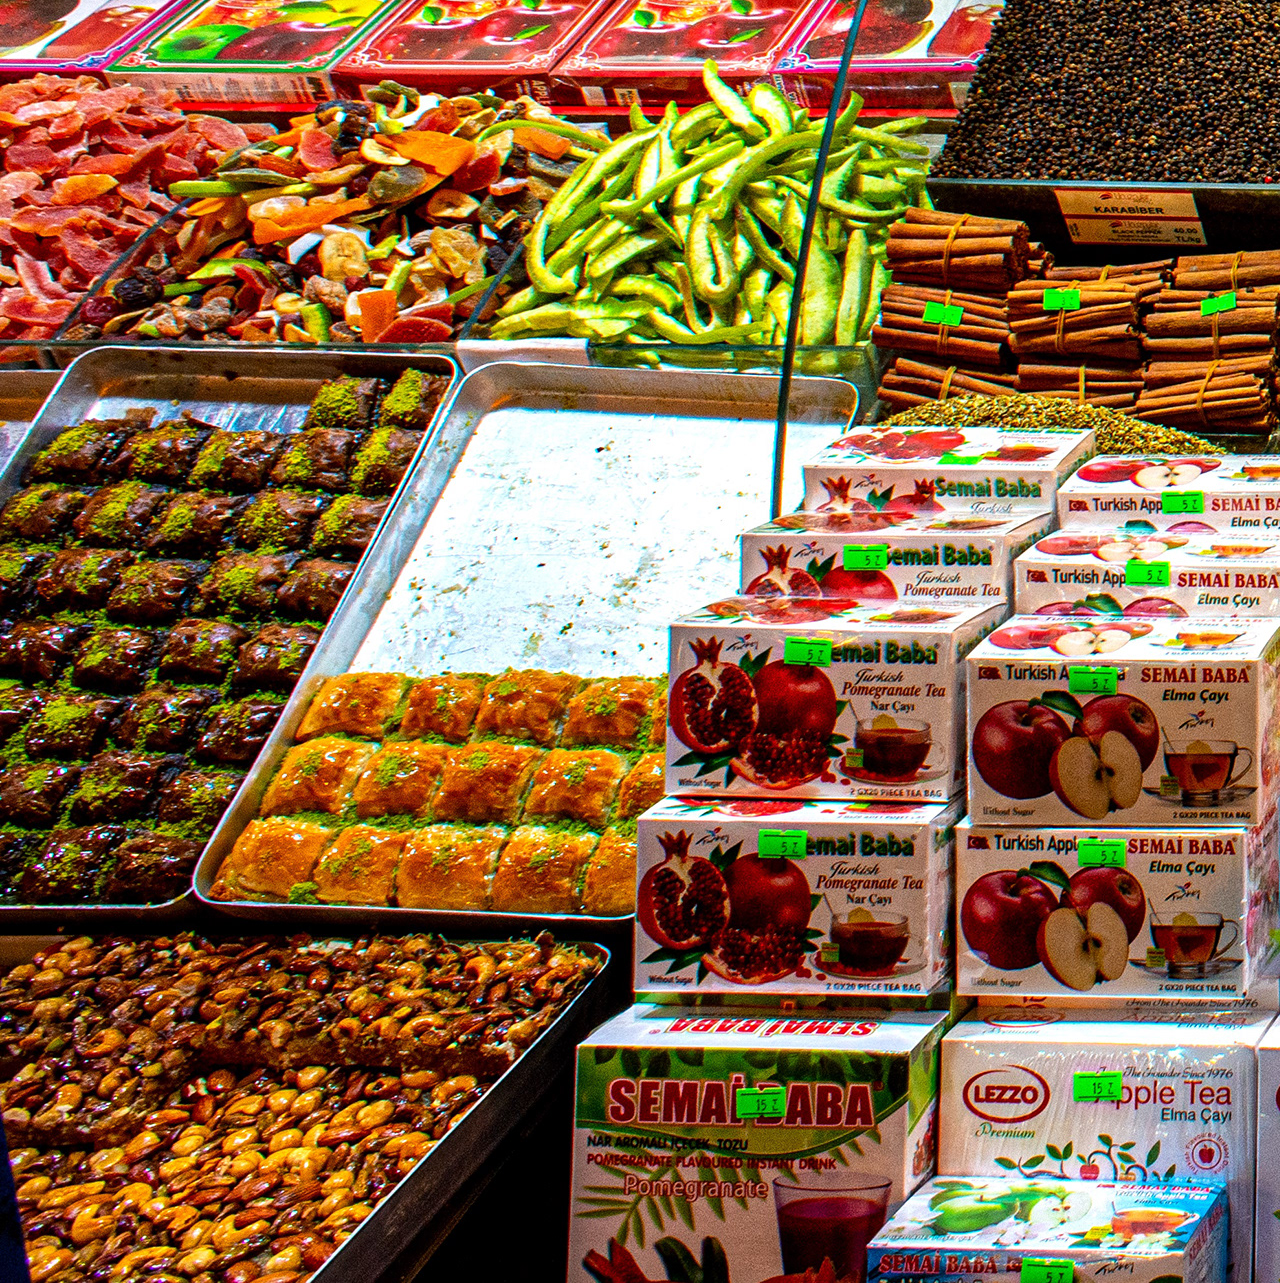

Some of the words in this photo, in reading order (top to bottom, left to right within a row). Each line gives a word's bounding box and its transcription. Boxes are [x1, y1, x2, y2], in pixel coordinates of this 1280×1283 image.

[1093, 205, 1165, 215] KARABİBER
[1092, 498, 1135, 512] Turkish
[1211, 493, 1260, 511] SEMAİ
[1231, 516, 1260, 527] Elma
[1177, 570, 1229, 588] SEMAİ
[1235, 572, 1279, 588] BABA
[904, 583, 981, 598] Pomegranate
[986, 584, 1000, 596] Tea
[1141, 664, 1196, 683] SEMAİ
[1202, 667, 1248, 683] BABA
[841, 683, 922, 700] Pomegranate
[927, 683, 945, 696] Tea
[870, 701, 889, 711] Nar
[892, 700, 915, 713] Çayı
[974, 1086, 1037, 1104] LEZZO
[977, 1124, 1035, 1141] Premium
[587, 1155, 672, 1168] POMEGRANATE
[675, 1156, 743, 1168] FLAVOURED
[748, 1158, 799, 1170] INSTANT
[802, 1158, 836, 1170] DRINK
